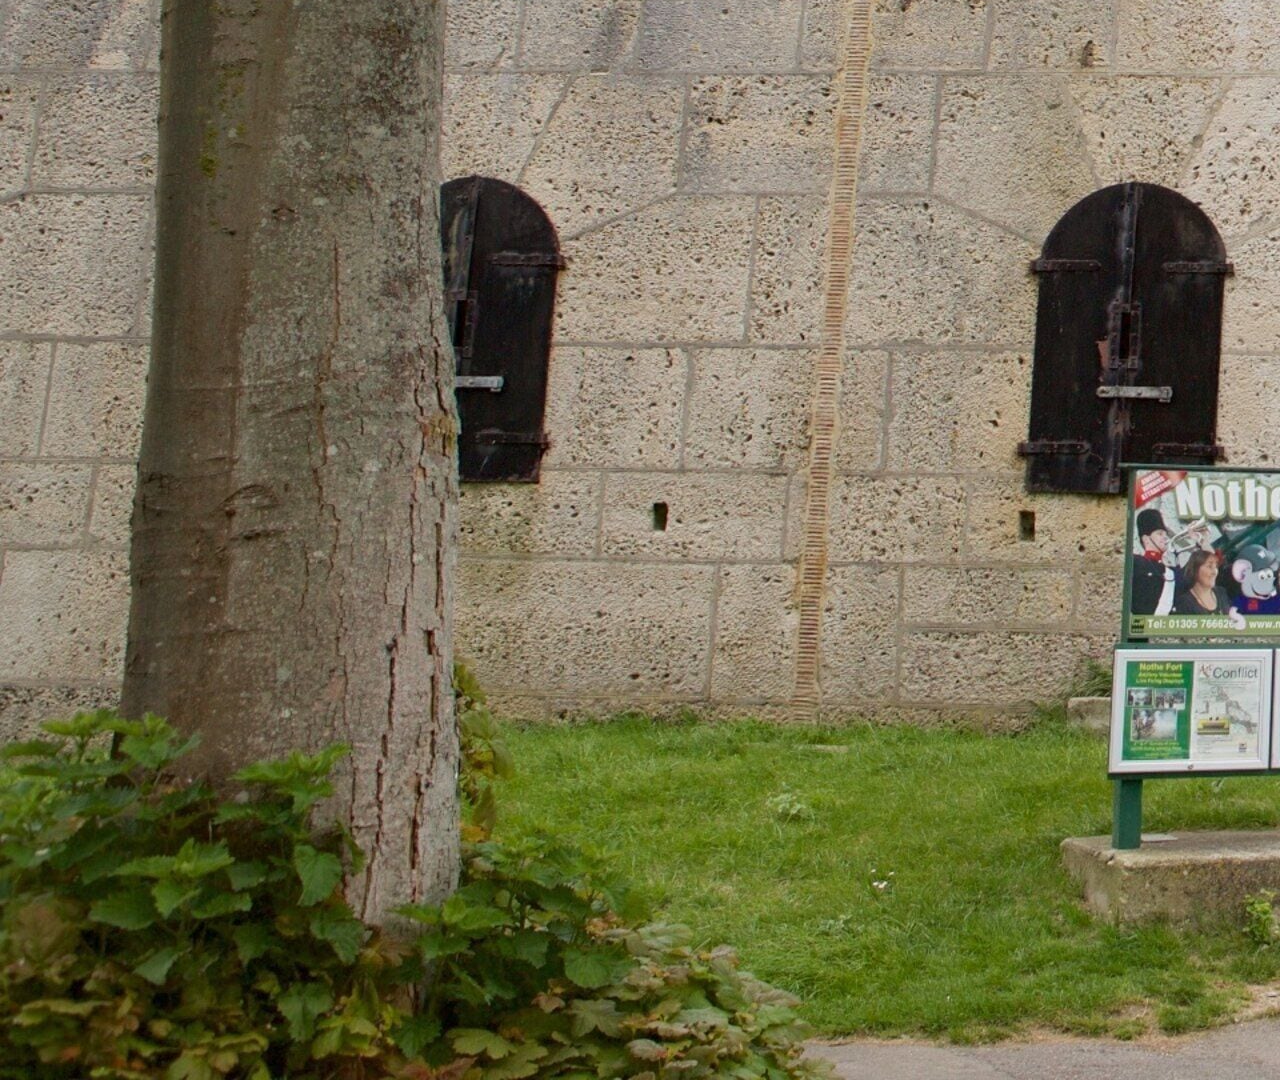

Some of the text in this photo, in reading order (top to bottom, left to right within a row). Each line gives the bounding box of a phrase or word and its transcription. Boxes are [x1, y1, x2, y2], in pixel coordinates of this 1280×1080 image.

[1147, 619, 1166, 629] Tel:
[1168, 619, 1198, 629] 01305
[1139, 662, 1182, 671] Nothe Fort
[1212, 667, 1258, 679] Conflict
